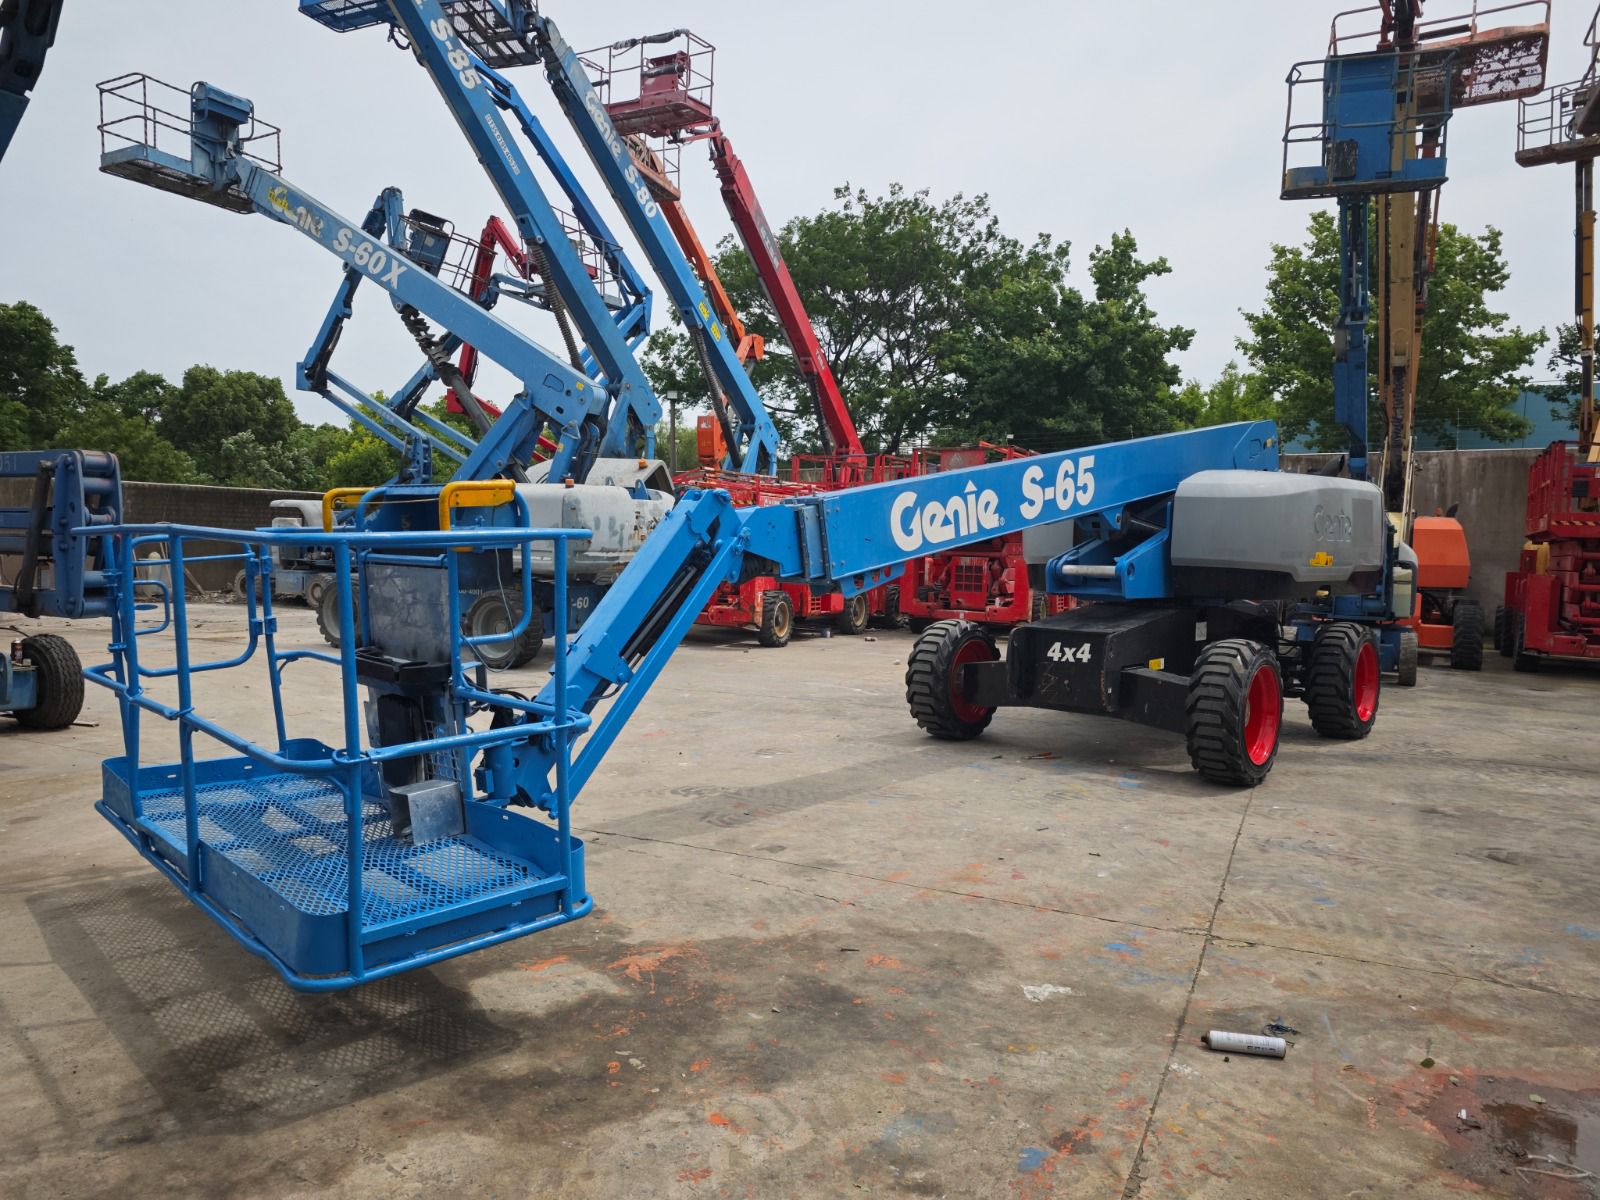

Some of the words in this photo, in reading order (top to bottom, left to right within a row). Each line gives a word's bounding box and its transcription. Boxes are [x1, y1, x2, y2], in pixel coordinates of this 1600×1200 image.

[430, 18, 481, 89] S-85
[585, 90, 622, 158] Genie
[624, 163, 658, 218] S-80
[890, 480, 1001, 552] Genie
[1019, 455, 1095, 520] S-65
[1047, 642, 1092, 663] 4x4
